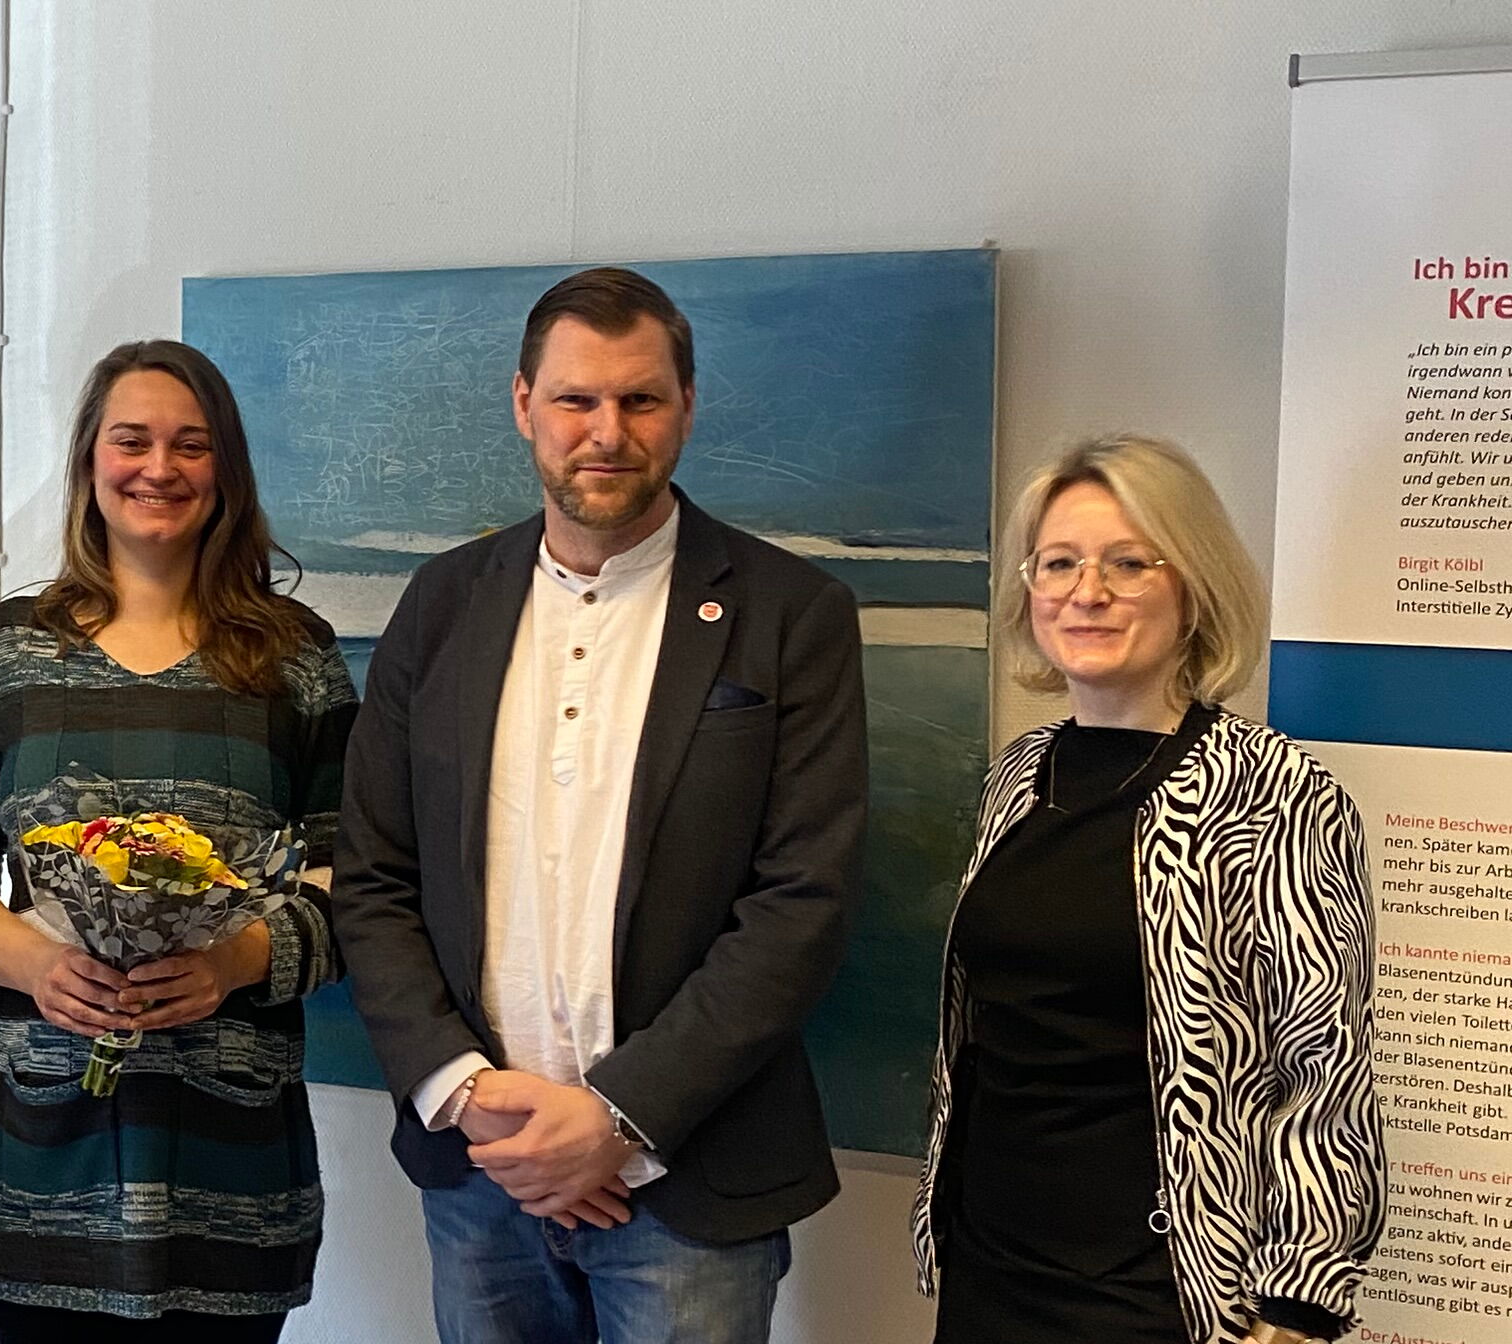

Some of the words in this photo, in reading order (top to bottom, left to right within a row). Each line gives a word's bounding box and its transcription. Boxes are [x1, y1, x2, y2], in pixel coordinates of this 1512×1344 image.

[1415, 257, 1454, 279] Ich
[1464, 257, 1508, 279] bin
[1445, 344, 1468, 356] bin
[1474, 345, 1497, 356] ein
[1408, 364, 1502, 380] irgendwann
[1407, 386, 1479, 399] Niemand
[1405, 409, 1444, 423] geht.
[1451, 409, 1465, 421] In
[1471, 409, 1497, 421] der
[1405, 430, 1469, 442] anderen
[1403, 451, 1463, 466] anfühlt.
[1471, 452, 1499, 464] Wir
[1403, 472, 1432, 485] und
[1437, 473, 1485, 488] geben
[1402, 494, 1427, 506] der
[1432, 494, 1511, 508] Krankheit.
[1399, 557, 1439, 573] Birgit
[1445, 558, 1483, 571] Kölbl
[1397, 600, 1490, 615] Interstitielle
[1386, 814, 1435, 829] Meine
[1385, 837, 1417, 849] nen.
[1422, 838, 1472, 853] Später
[1384, 858, 1424, 871] mehr
[1430, 859, 1451, 873] bis
[1456, 865, 1480, 875] zur
[1383, 879, 1423, 893] mehr
[1382, 899, 1499, 920] krankschreiben
[1380, 943, 1400, 956] Ich
[1406, 944, 1458, 961] kannte
[1377, 1006, 1404, 1021] den
[1410, 1011, 1456, 1026] vielen
[1375, 1028, 1411, 1043] kann
[1416, 1033, 1444, 1046] sich
[1374, 1050, 1399, 1063] der
[1374, 1073, 1449, 1090] zerstören.
[1394, 1095, 1467, 1115] Krankheit
[1473, 1104, 1507, 1119] gibt.
[1401, 1162, 1453, 1178] treffen
[1459, 1171, 1487, 1181] uns
[1389, 1205, 1478, 1225] meinschaft.
[1484, 1214, 1497, 1228] In
[1388, 1226, 1423, 1239] ganz
[1427, 1230, 1467, 1248] aktiv,
[1439, 1254, 1485, 1270] sofort
[1363, 1287, 1445, 1311] tentlösung
[1450, 1299, 1480, 1312] gibt
[1485, 1305, 1501, 1315] es
[1360, 1328, 1387, 1343] Der
